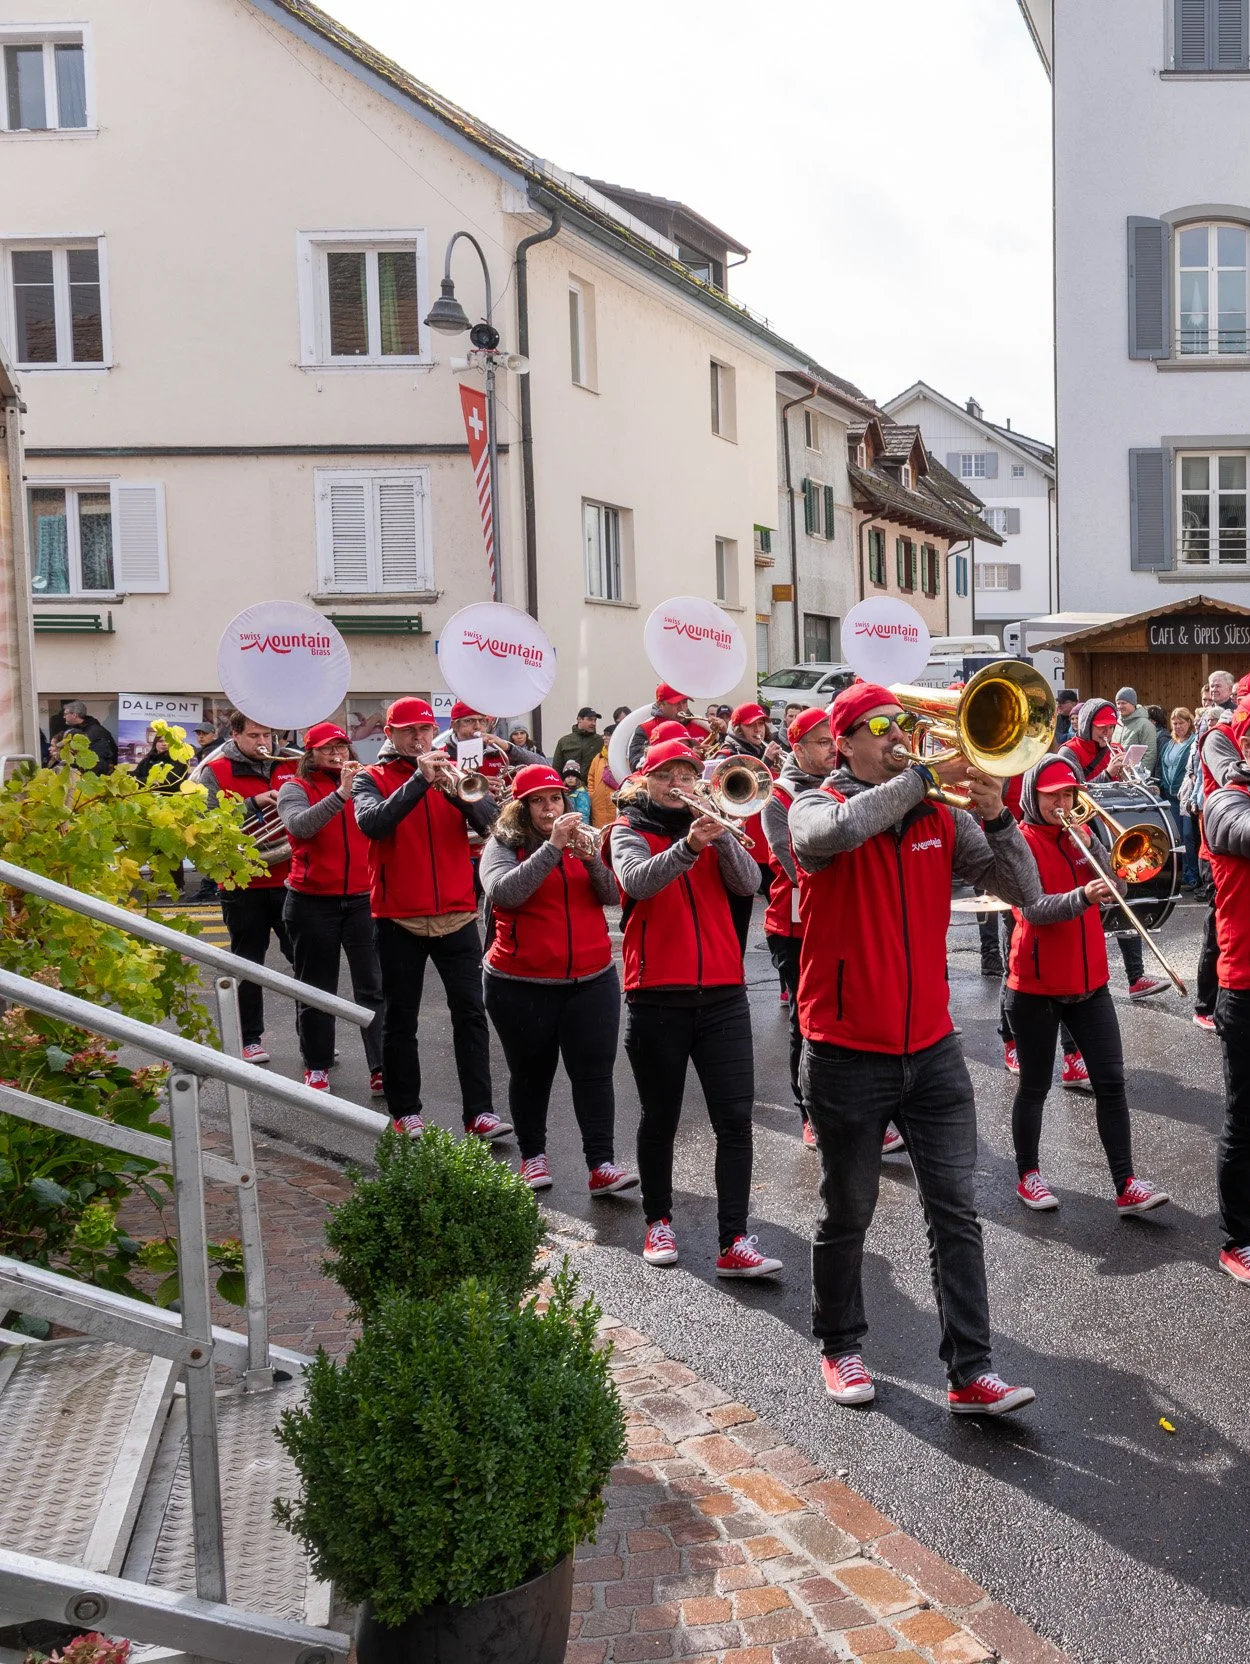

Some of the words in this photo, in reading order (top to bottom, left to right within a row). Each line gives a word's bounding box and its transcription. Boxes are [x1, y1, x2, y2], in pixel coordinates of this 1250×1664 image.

[240, 631, 260, 641] swiss
[463, 630, 482, 640] swiss
[663, 622, 732, 644] Mountain
[1178, 625, 1189, 645] &
[1194, 624, 1220, 645] ÖPPIS
[240, 632, 330, 654] Mountain
[462, 638, 543, 661] Mountain
[311, 648, 331, 656] Brass
[122, 700, 199, 712] DALPONT
